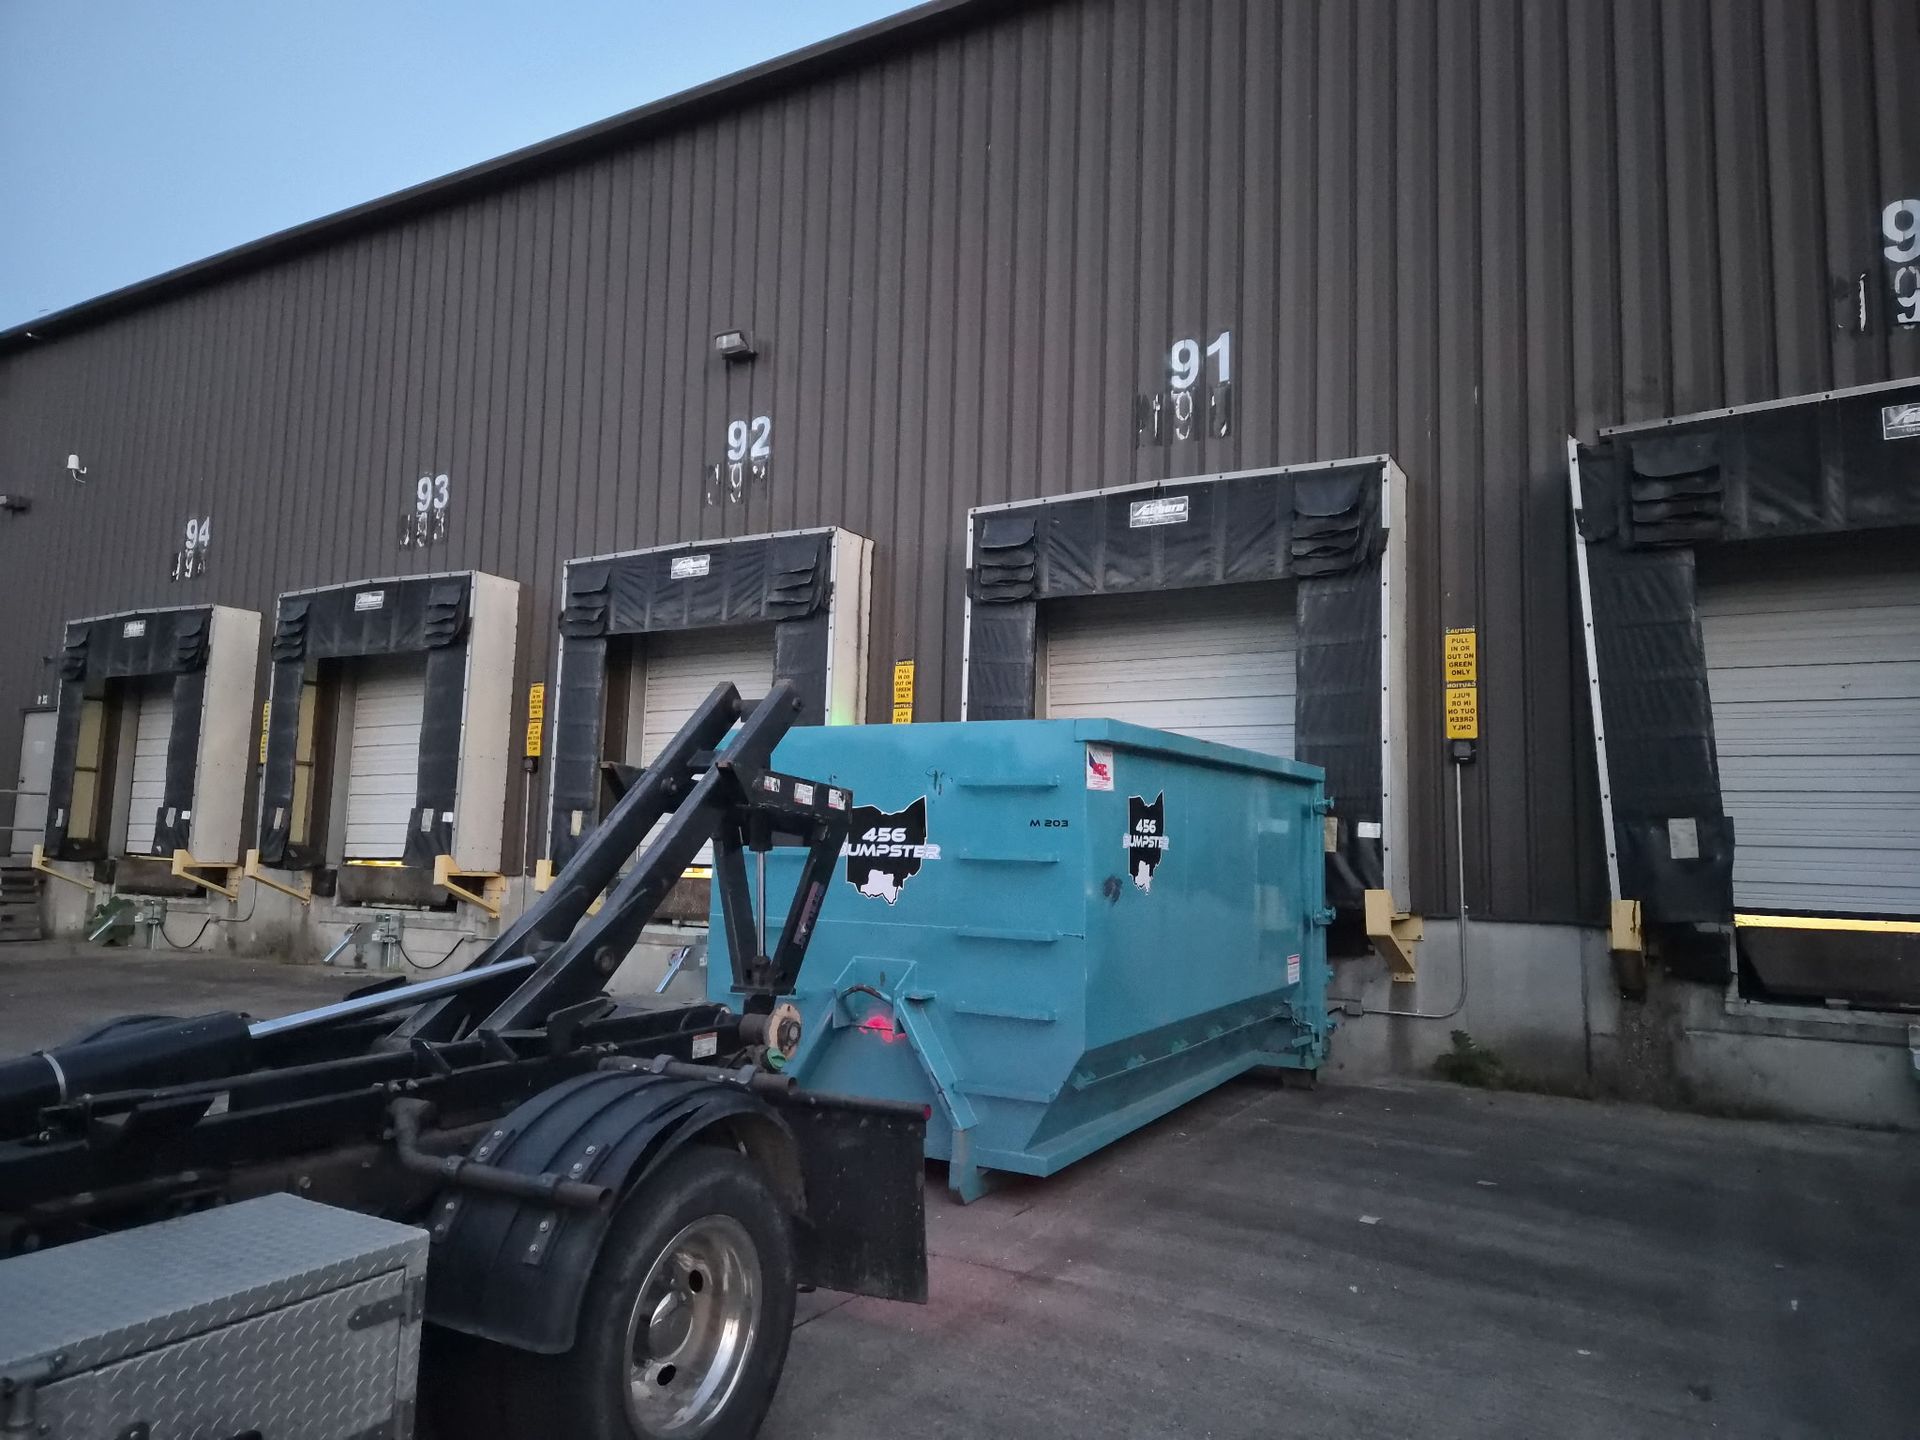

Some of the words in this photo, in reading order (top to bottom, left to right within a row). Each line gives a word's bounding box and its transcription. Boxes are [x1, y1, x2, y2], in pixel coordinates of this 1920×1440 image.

[1171, 331, 1230, 389] 91
[727, 415, 771, 461] 92
[417, 474, 449, 512] 93
[185, 516, 210, 549] 94
[862, 827, 907, 843] 456
[1029, 819, 1041, 827] M
[1044, 819, 1069, 828] 203
[1135, 818, 1157, 834] 456
[1122, 833, 1170, 851] DUMPSTER
